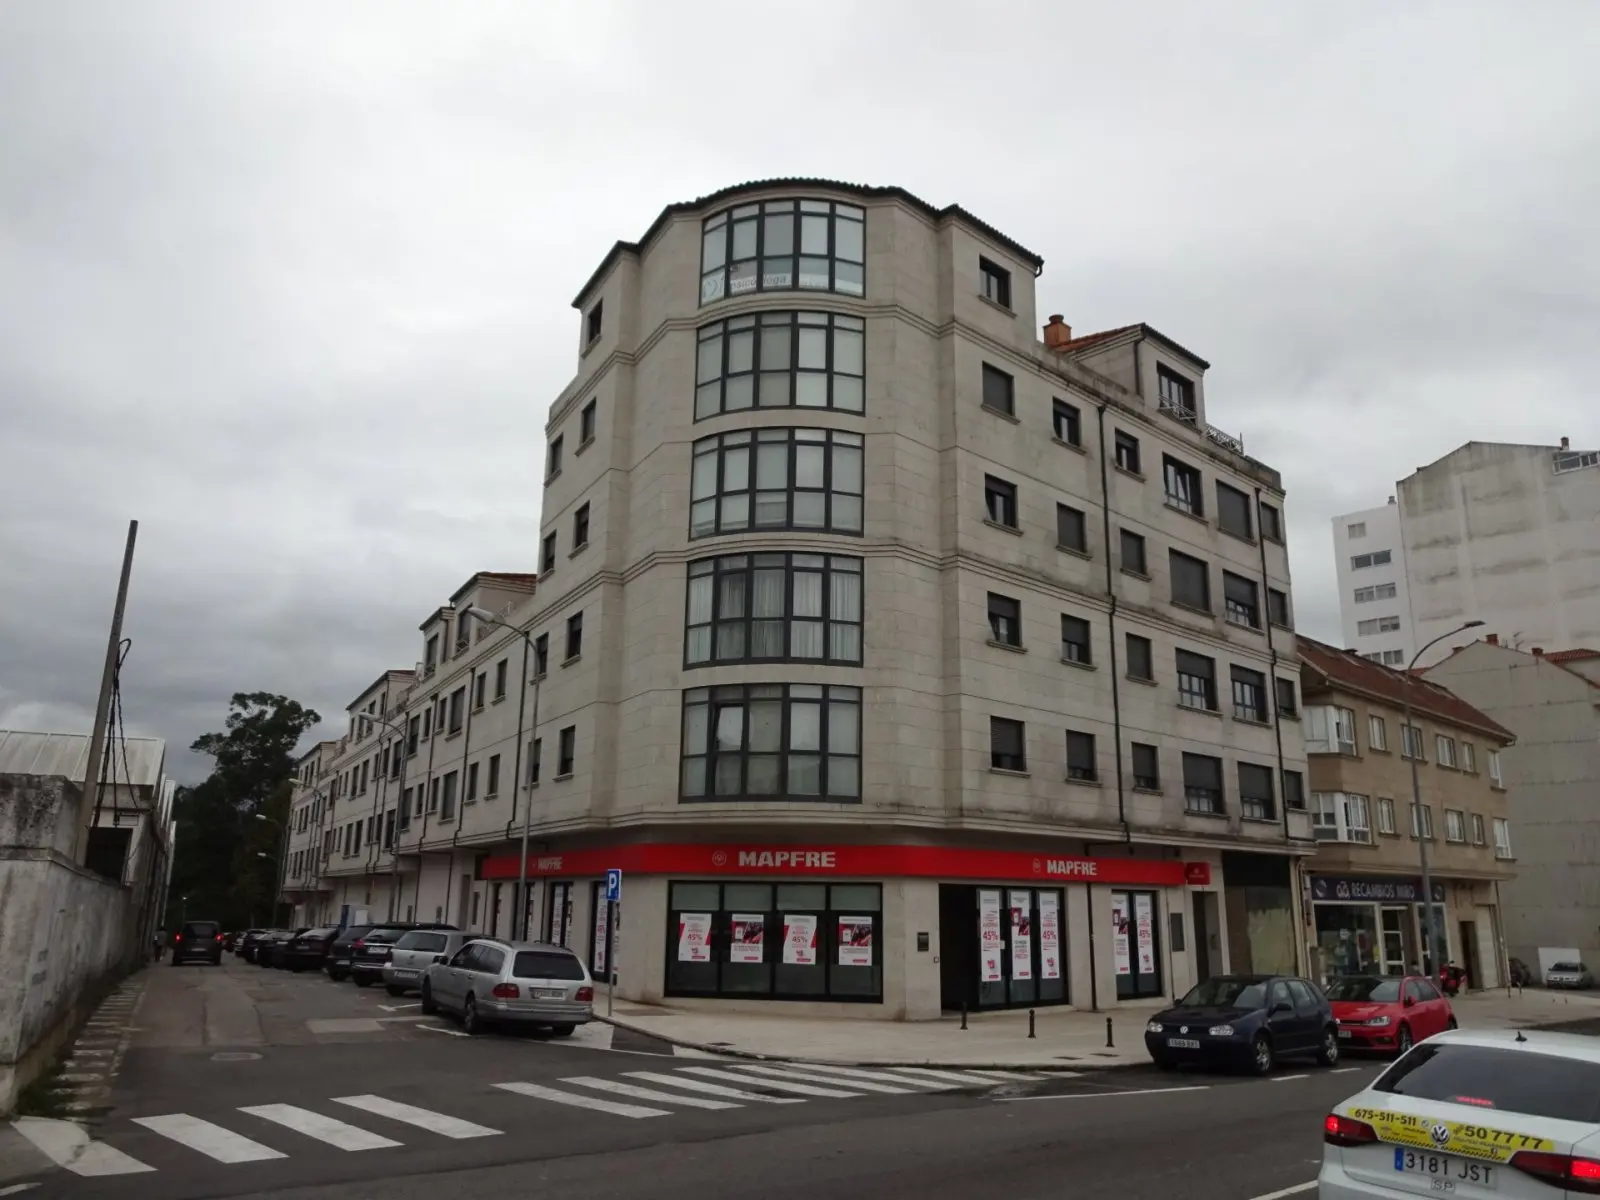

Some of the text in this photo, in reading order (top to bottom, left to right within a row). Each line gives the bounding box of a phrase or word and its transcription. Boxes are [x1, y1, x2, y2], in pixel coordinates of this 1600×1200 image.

[737, 851, 836, 868] MAPFRE
[1046, 859, 1098, 876] MAPFRE
[608, 873, 617, 896] P
[1351, 882, 1395, 898] RECAMBIOS
[1354, 1108, 1417, 1126] 675-511-511
[1405, 1152, 1493, 1184] 3181 JST
[1434, 1179, 1453, 1193] SP
